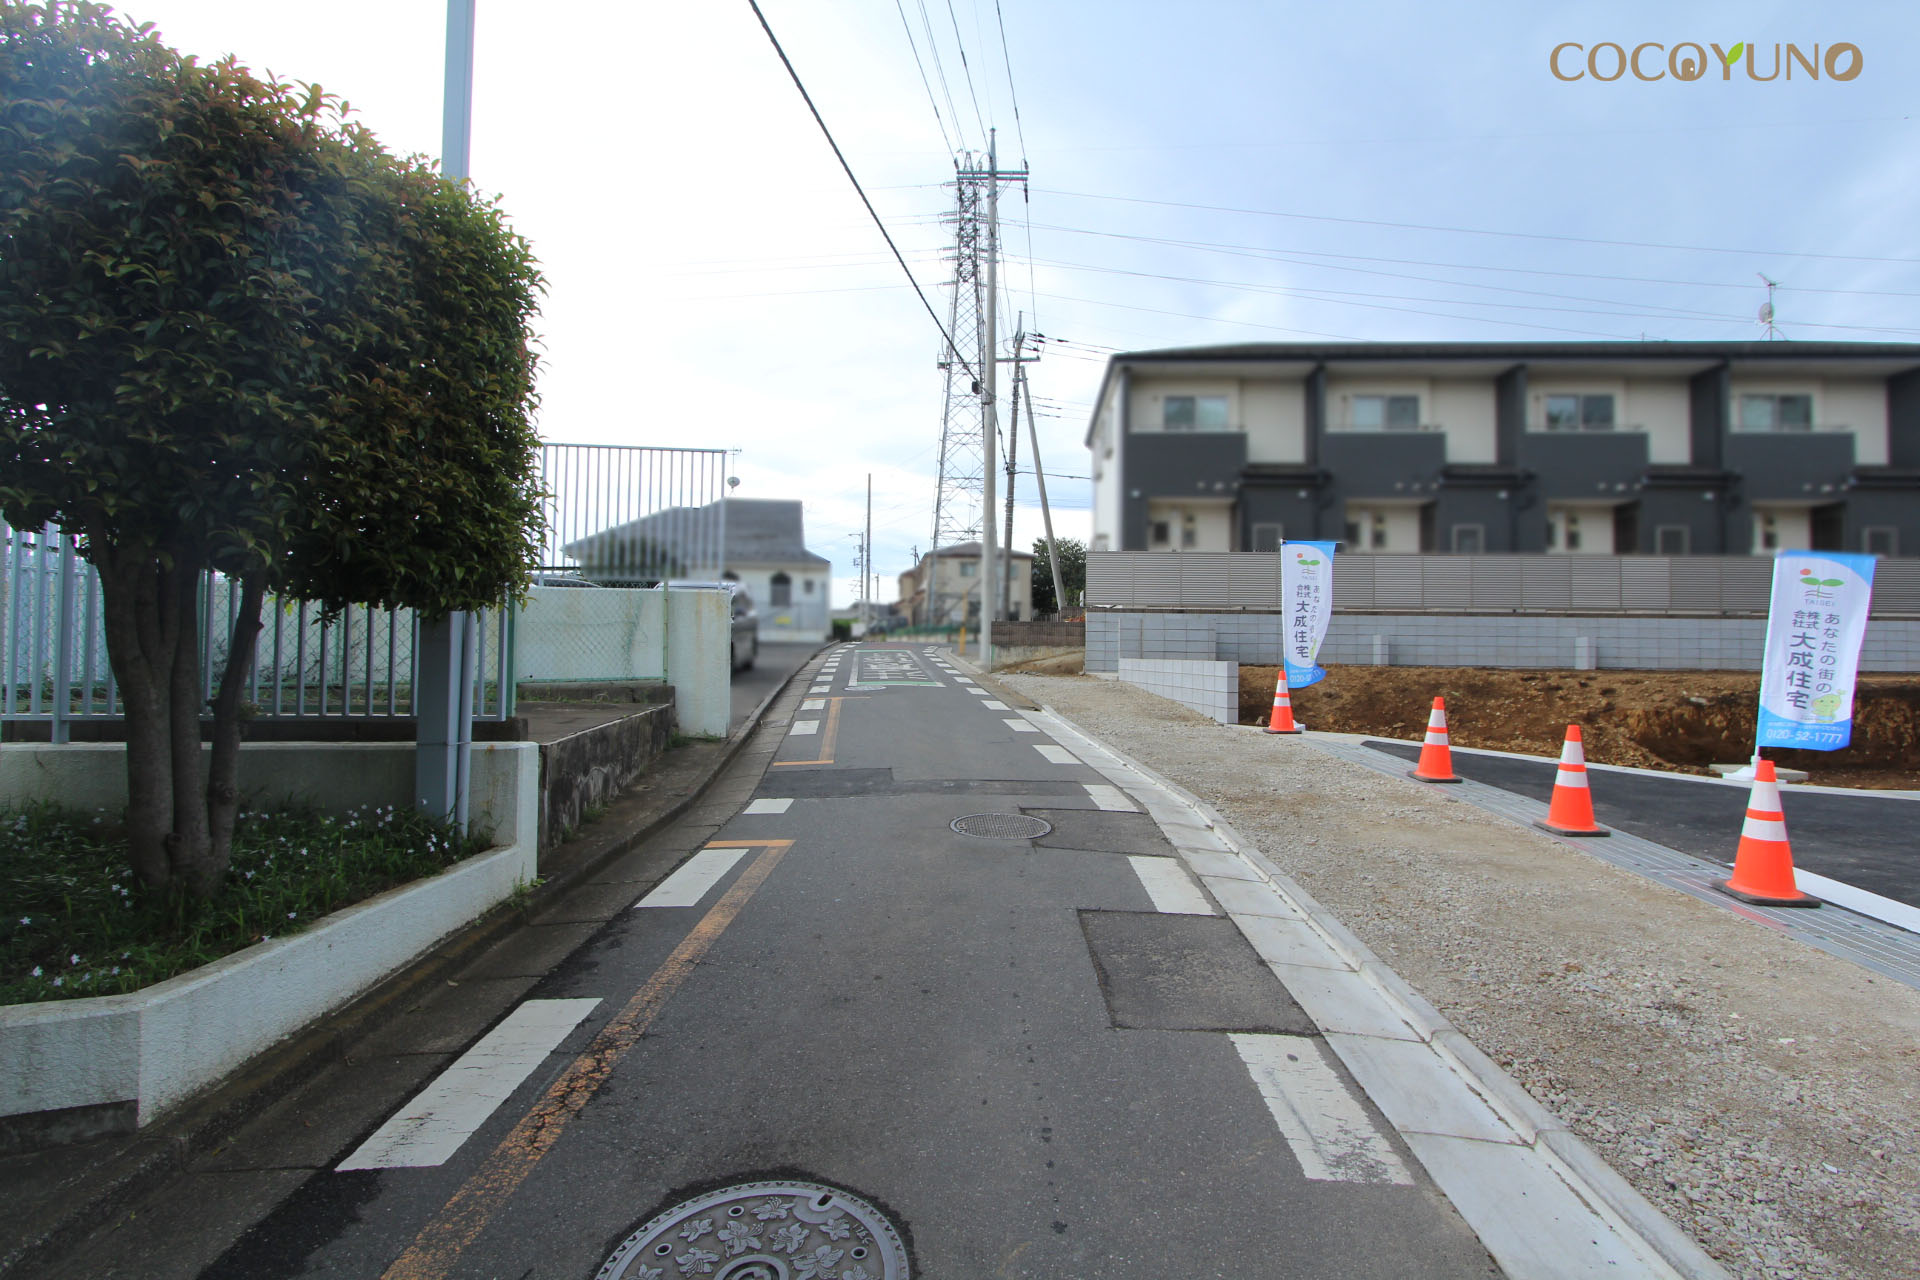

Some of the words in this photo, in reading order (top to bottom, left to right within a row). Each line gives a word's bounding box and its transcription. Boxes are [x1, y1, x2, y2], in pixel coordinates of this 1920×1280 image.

[1792, 610, 1820, 630] 株式会社
[1804, 598, 1835, 607] TAISEI
[1293, 600, 1310, 659] 大成住宅
[1786, 631, 1816, 709] 大成住宅
[1816, 613, 1841, 694] あなたの街の
[1766, 728, 1843, 744] 0120-52-1777
